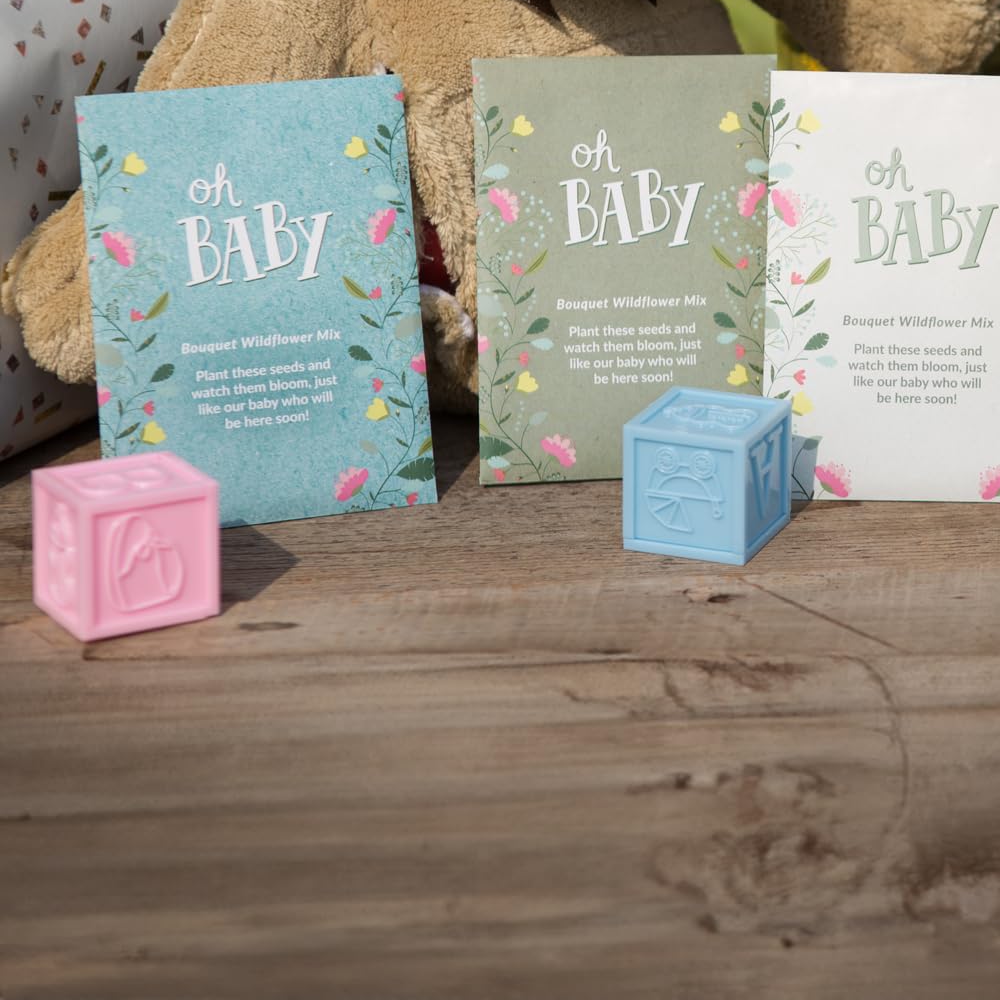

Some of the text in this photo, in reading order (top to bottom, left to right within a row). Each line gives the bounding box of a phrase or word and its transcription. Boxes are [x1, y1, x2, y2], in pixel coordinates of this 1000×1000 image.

[571, 129, 621, 172] oh
[865, 147, 914, 192] oh
[189, 163, 242, 207] oh
[560, 169, 704, 247] BABY
[852, 189, 999, 270] BABY
[177, 201, 333, 287] BABY
[557, 295, 706, 310] Bouquet Wildflower Mix
[569, 323, 696, 337] Plant these seeds and
[843, 315, 994, 328] Bouquet Wildflower Mix
[181, 329, 341, 354] Bouquet Wildflower Mix
[564, 339, 702, 353] watch them bloom, just
[854, 344, 982, 356] Plant these seeds and
[196, 358, 331, 382] Plant these seeds and
[570, 355, 697, 369] like our baby who will
[849, 360, 987, 374] watch them bloom, just
[192, 375, 338, 399] watch them bloom, just
[594, 371, 673, 384] be here soon!
[853, 376, 981, 389] like our baby who will
[198, 391, 333, 415] like our baby who will
[877, 392, 957, 404] be here soon!
[225, 410, 309, 429] be here soon!
